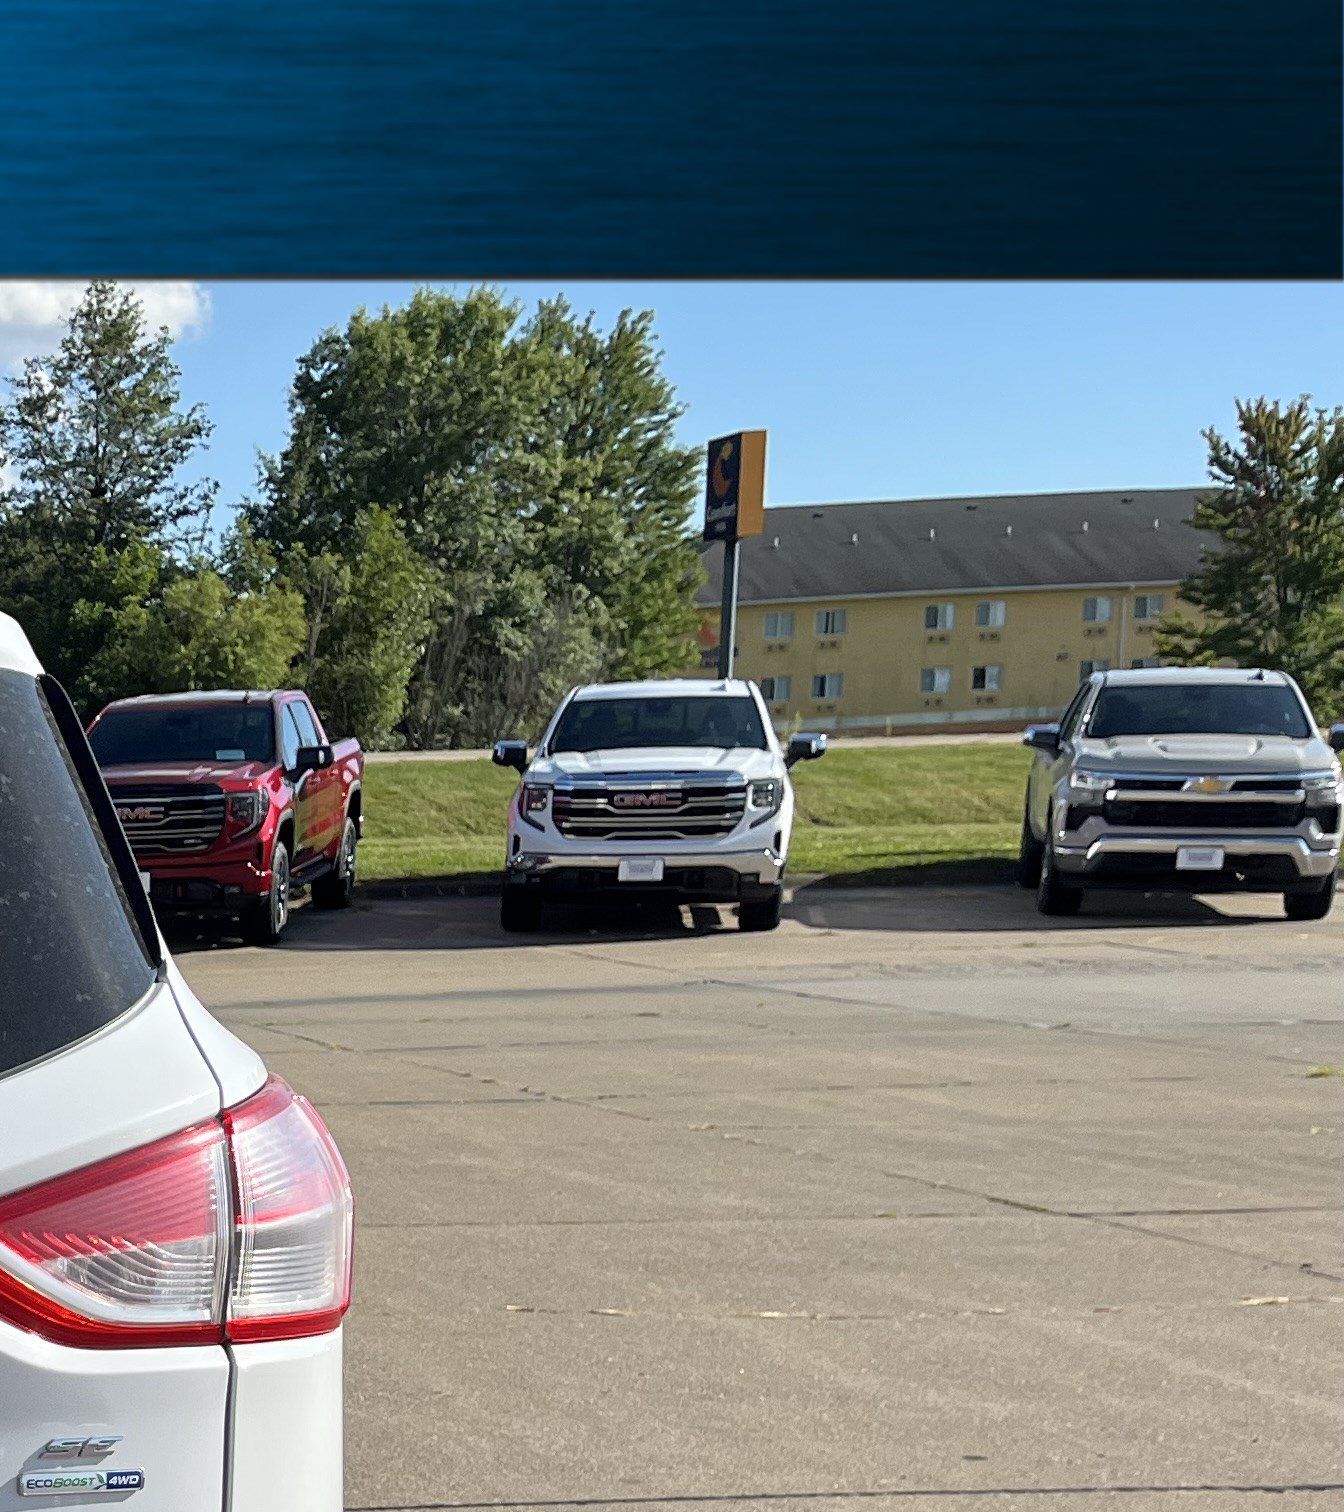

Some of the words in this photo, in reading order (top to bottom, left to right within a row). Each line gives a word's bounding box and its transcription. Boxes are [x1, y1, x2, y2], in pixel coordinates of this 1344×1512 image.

[613, 792, 683, 807] GMC
[116, 806, 165, 821] MC
[38, 1434, 124, 1460] SE
[108, 1474, 140, 1486] 4WD
